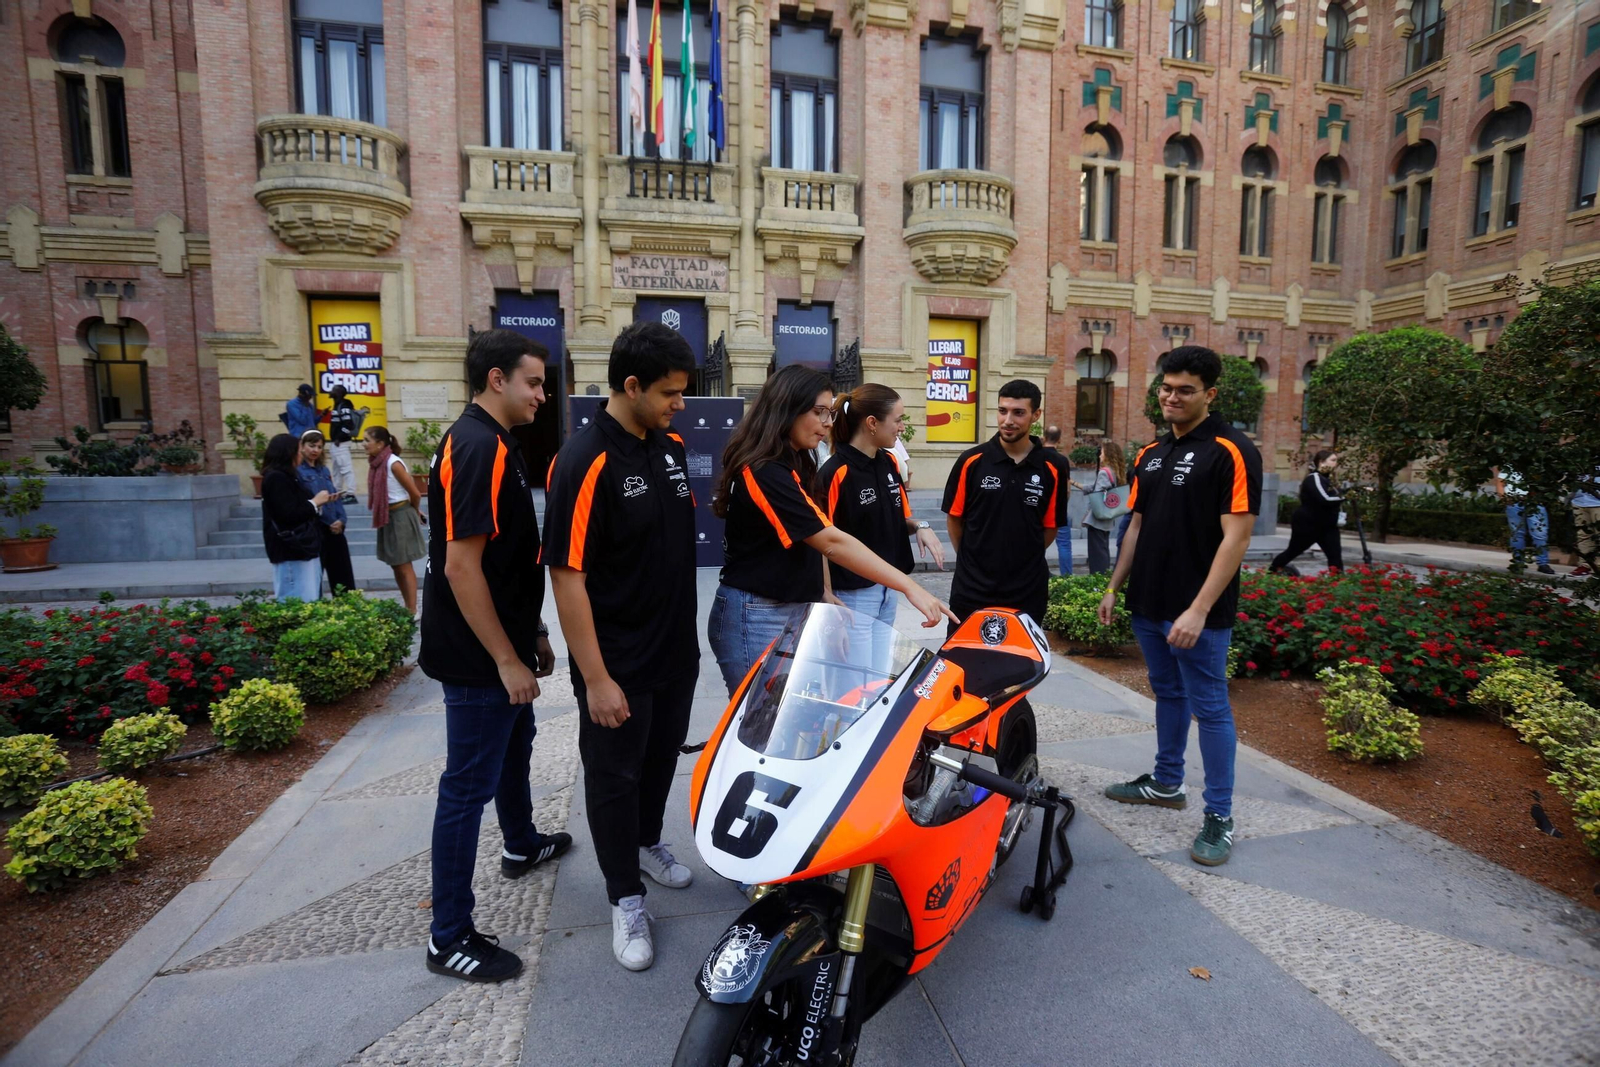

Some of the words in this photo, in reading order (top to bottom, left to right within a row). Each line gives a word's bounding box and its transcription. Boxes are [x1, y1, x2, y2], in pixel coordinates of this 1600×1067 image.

[630, 256, 709, 271] FACVLTAD
[620, 275, 720, 290] VETERINARIA
[500, 316, 556, 326] RECTORADO
[320, 325, 368, 341] LLEGAR
[779, 325, 829, 335] RECTORADO
[343, 343, 368, 353] LEJOS
[928, 341, 962, 354] LLEGAR
[327, 354, 354, 370] ESTÁ
[356, 357, 380, 369] MUY
[944, 356, 962, 366] LEJOS
[931, 366, 951, 380] ESTÁ
[953, 369, 970, 380] MUY
[926, 382, 968, 401] CERCA
[711, 771, 802, 859] 6
[796, 1026, 814, 1061] UCO
[806, 962, 830, 1024] ELECTRIC
